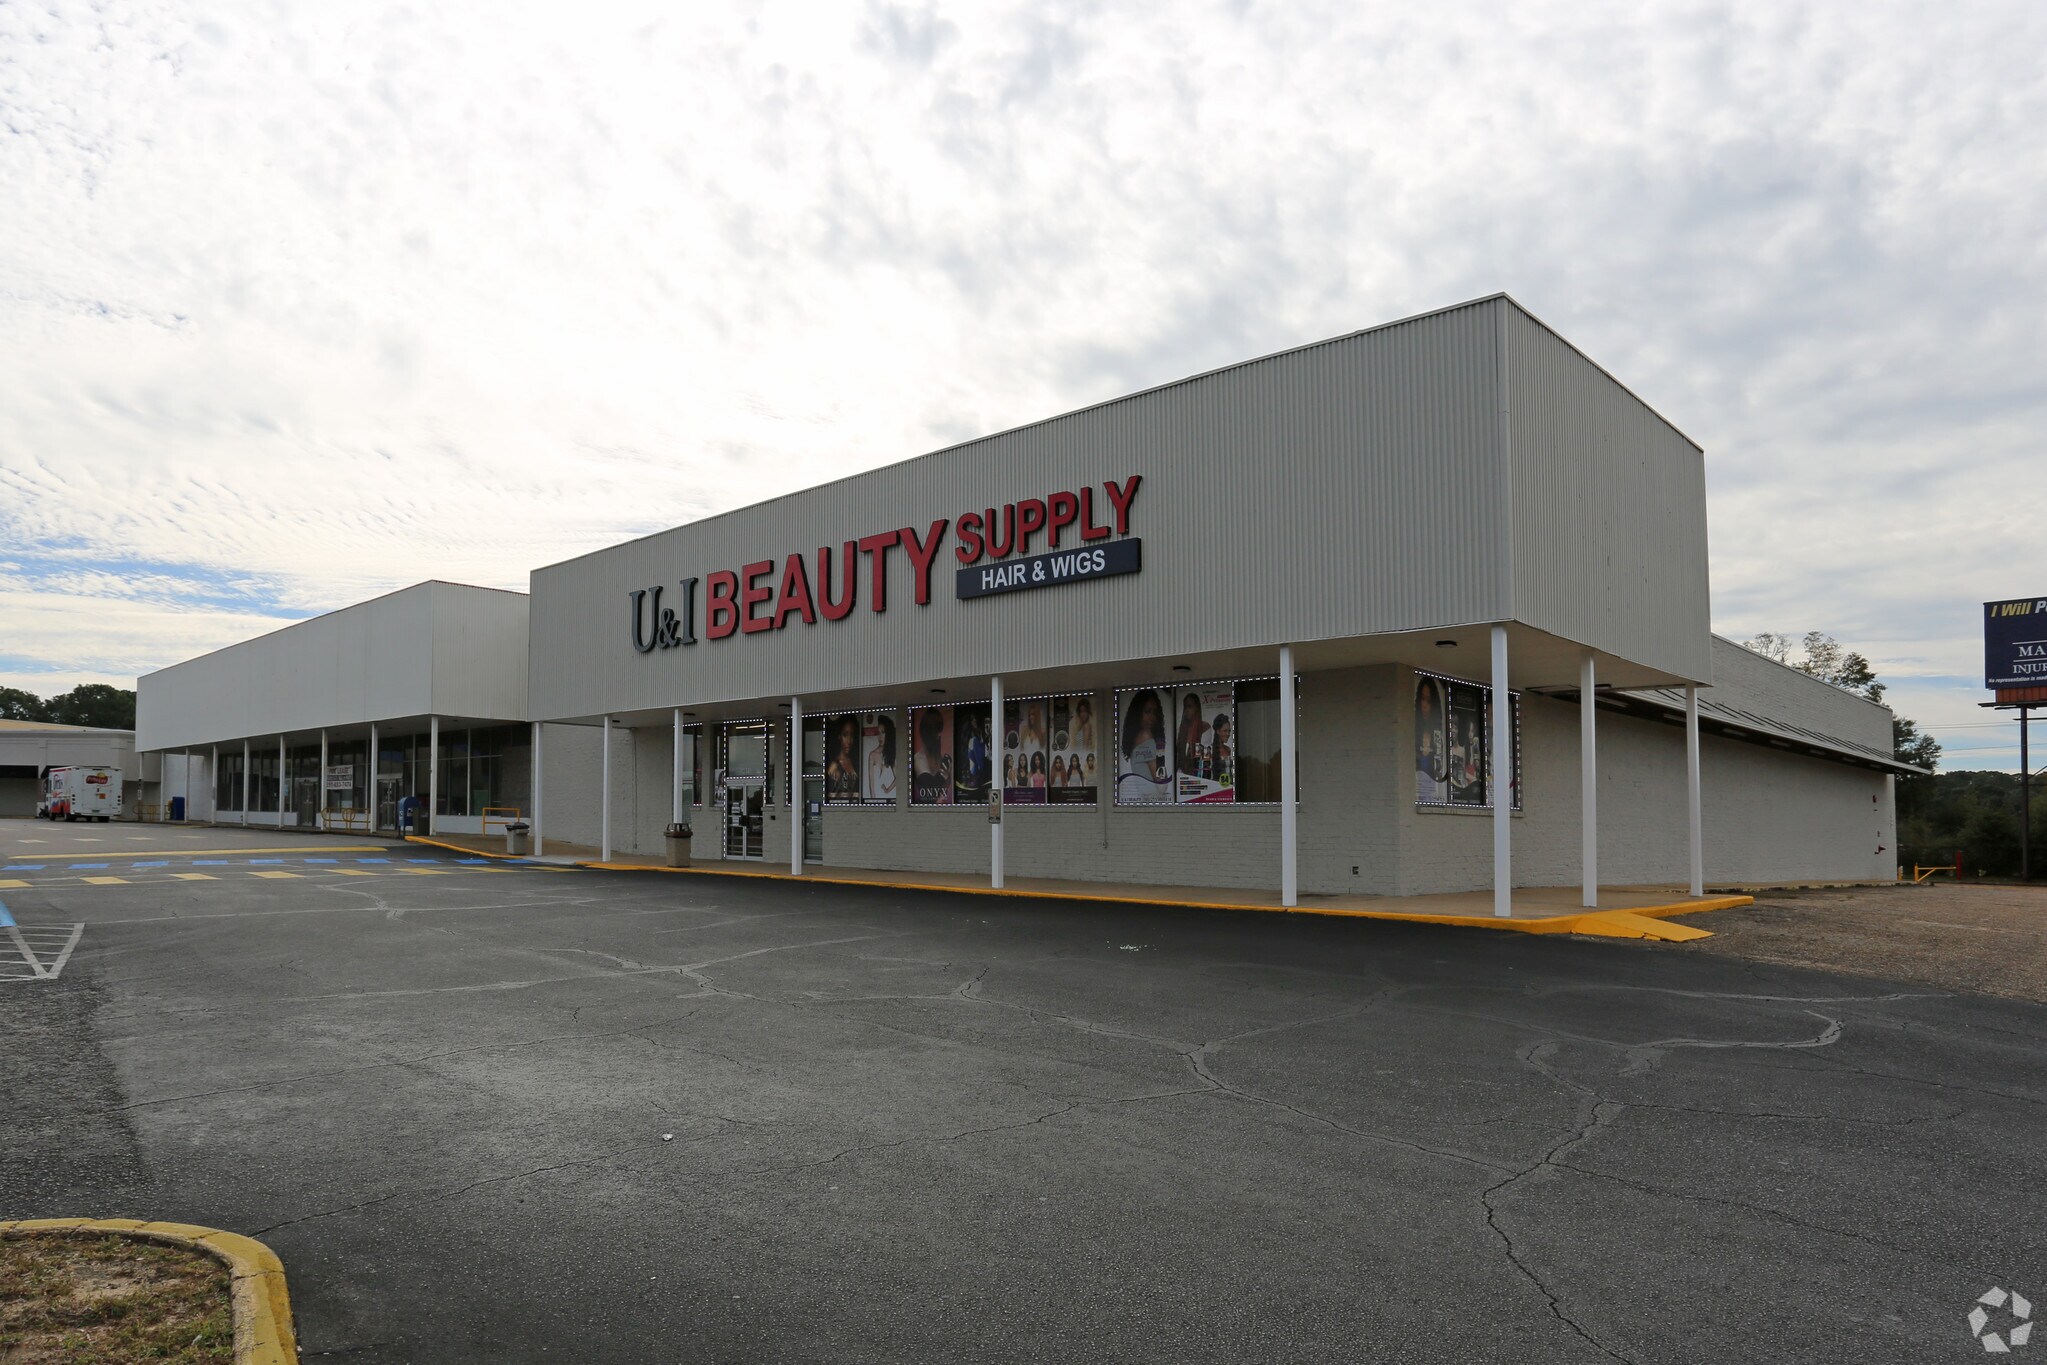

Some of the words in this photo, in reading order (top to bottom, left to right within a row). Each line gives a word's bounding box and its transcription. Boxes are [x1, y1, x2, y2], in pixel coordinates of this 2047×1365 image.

[955, 475, 1142, 564] SUPPLY
[706, 518, 949, 640] BEAUTY
[981, 563, 1027, 590] HAIR
[1031, 560, 1046, 582] &
[1050, 549, 1106, 578] WIGS
[1991, 605, 1998, 617] I
[2001, 602, 2032, 616] Will
[919, 787, 947, 797] ONYX
